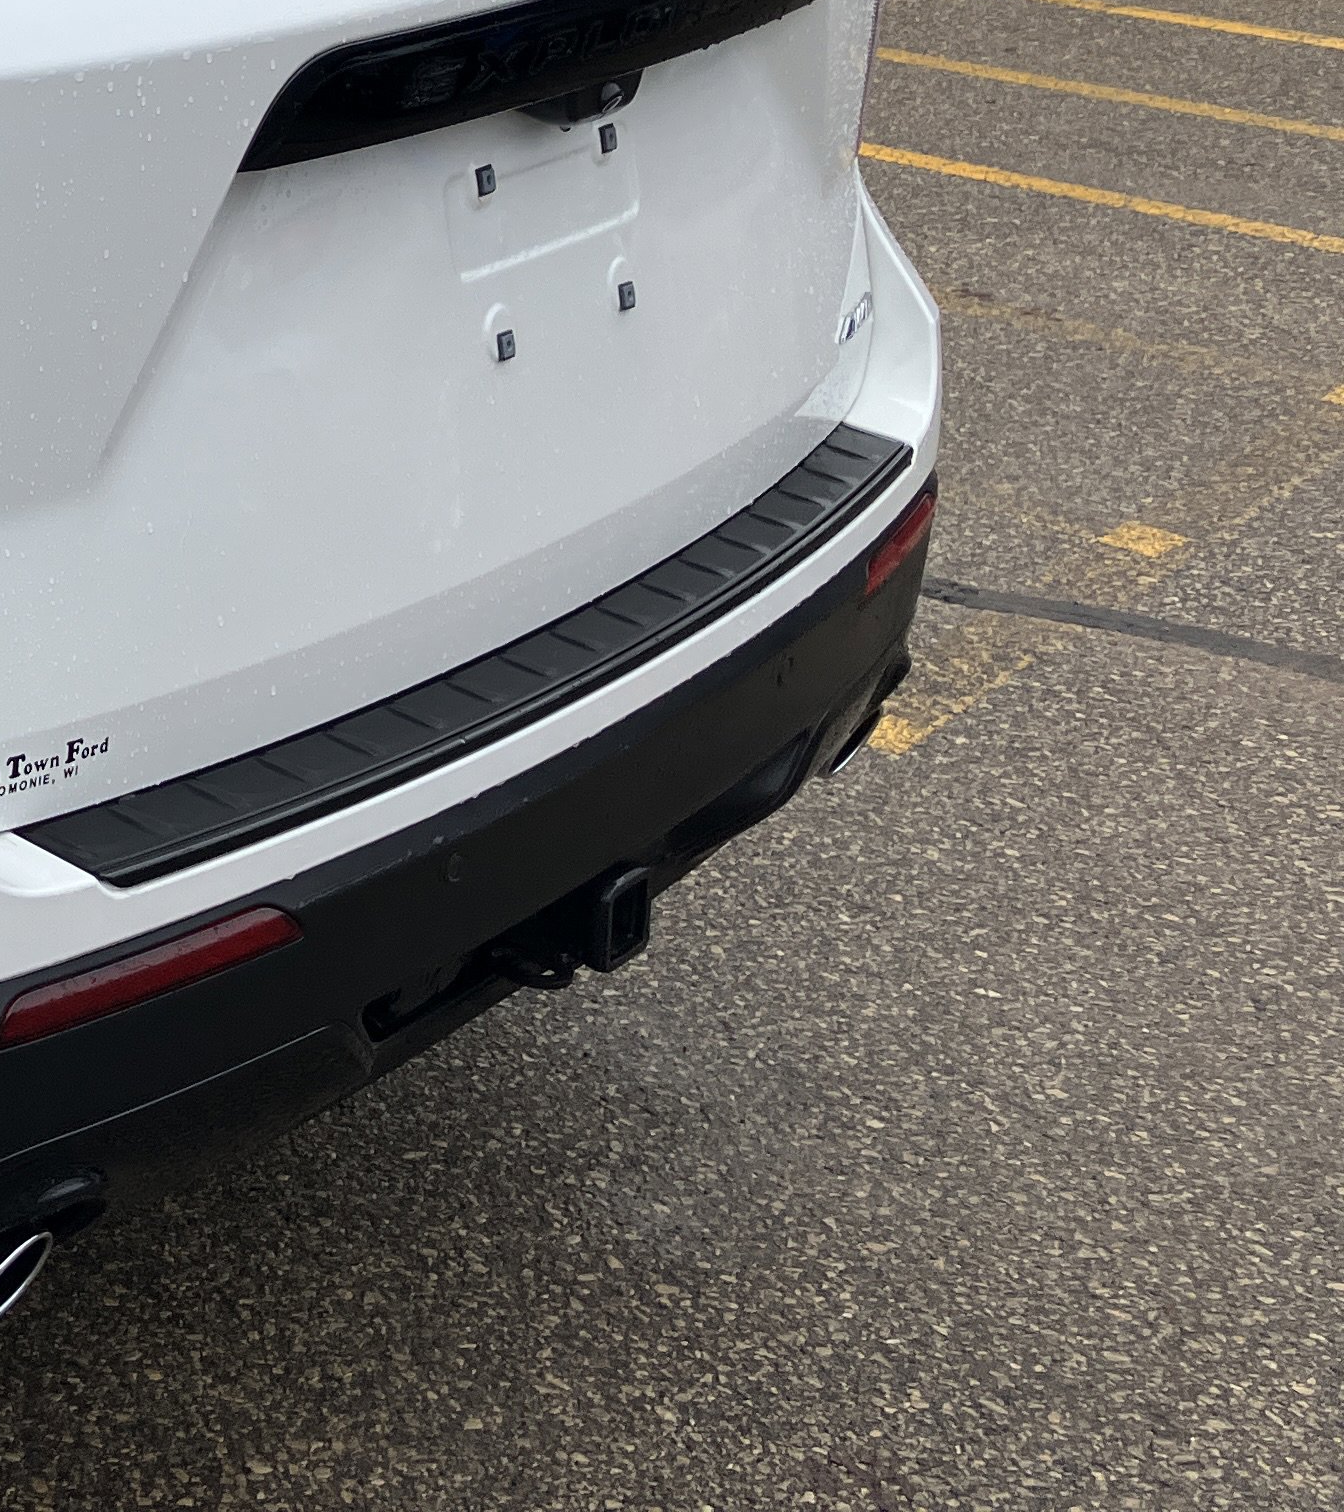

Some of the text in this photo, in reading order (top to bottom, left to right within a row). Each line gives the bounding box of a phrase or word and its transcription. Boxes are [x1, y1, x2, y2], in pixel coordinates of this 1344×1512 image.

[6, 753, 60, 779] Town
[64, 737, 110, 764] Ford
[64, 766, 79, 779] WI
